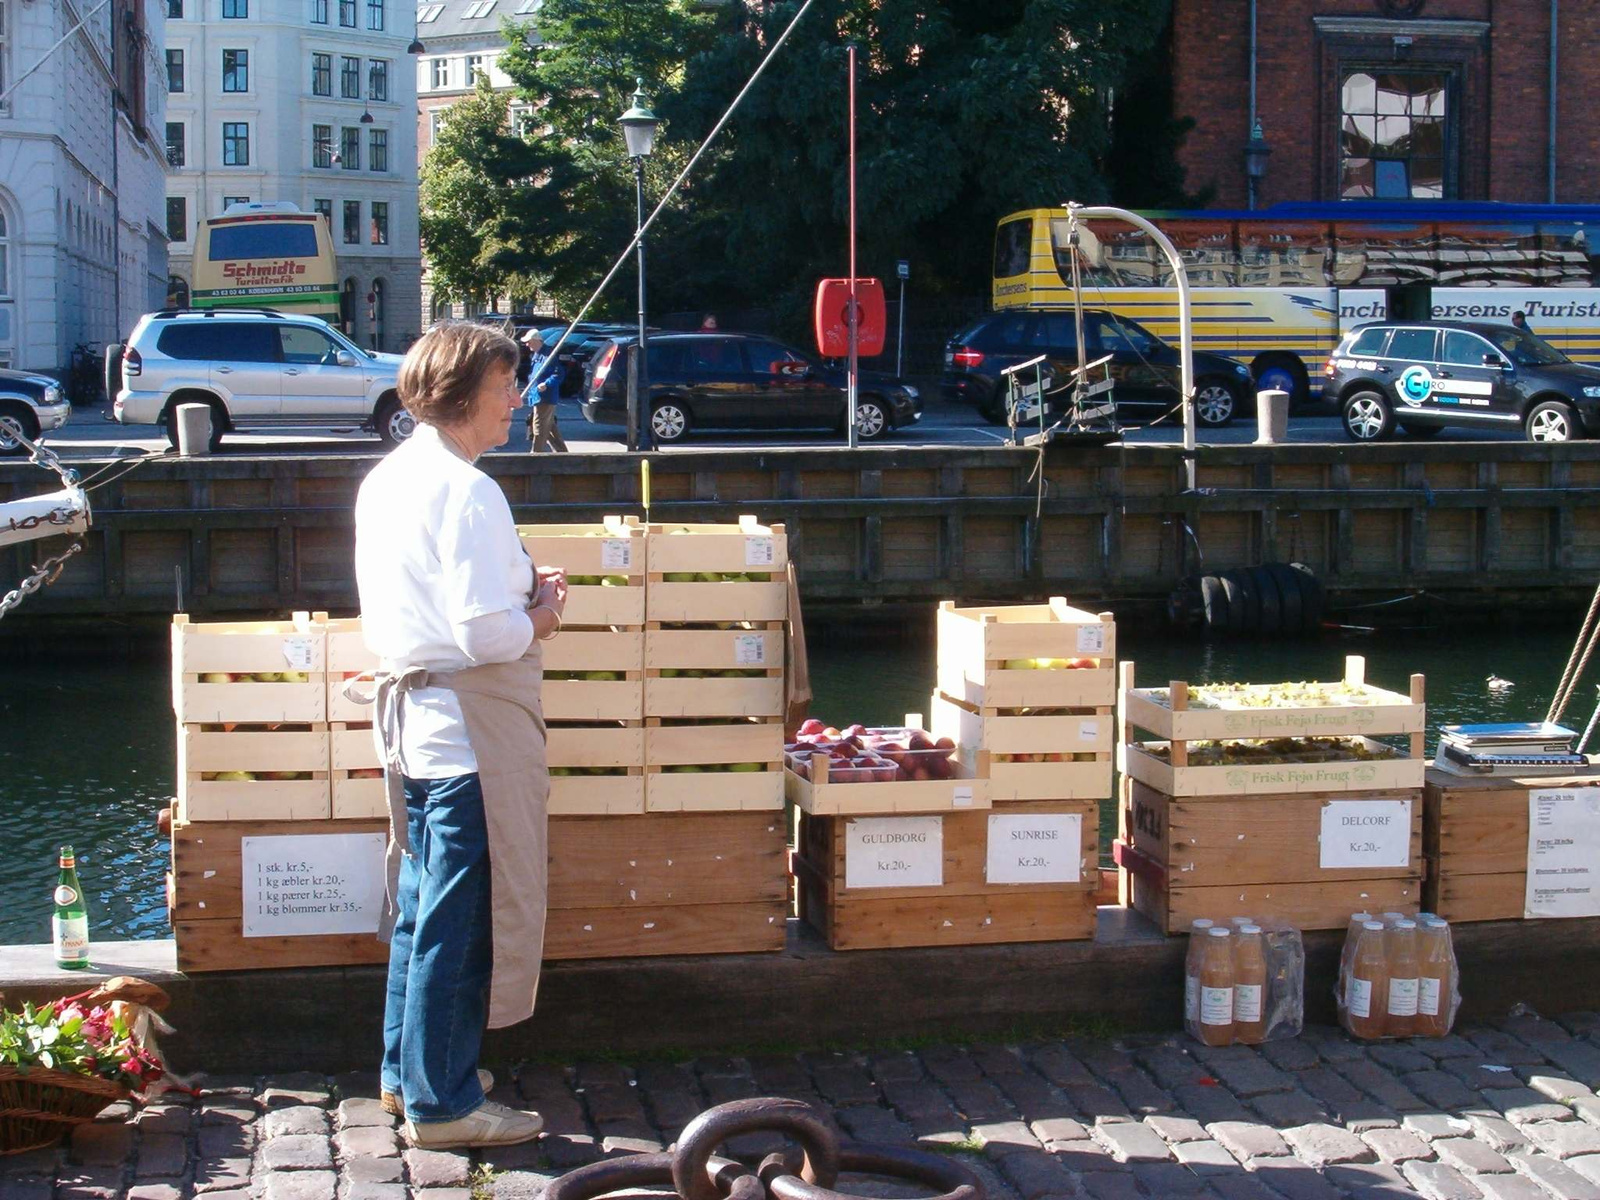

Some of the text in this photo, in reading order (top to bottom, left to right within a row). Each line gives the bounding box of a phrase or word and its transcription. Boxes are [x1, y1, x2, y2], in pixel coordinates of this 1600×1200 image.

[223, 260, 306, 277] Schmidts
[235, 275, 295, 285] Turisttrafik
[1524, 301, 1600, 317] Turist
[1251, 715, 1283, 727] Frisk
[1314, 714, 1347, 727] Frugt
[1252, 772, 1284, 784] Frisk
[1316, 770, 1350, 783] Frugt
[1342, 816, 1392, 826] DELCORF
[862, 832, 927, 844] GULDBORG
[1011, 830, 1058, 841] SUNRISE
[1350, 842, 1381, 852] Kr.20,-
[266, 862, 284, 873] stk.
[287, 862, 314, 873] kr.5,-
[878, 860, 912, 871] Kr.20,-
[1018, 857, 1051, 868] Kr.20,-
[266, 877, 279, 889] kg
[282, 876, 310, 886] æbler
[312, 875, 345, 886] kr.20,-
[266, 891, 279, 903] kg
[282, 892, 310, 902] pærer
[313, 889, 346, 900] kr.25,-
[267, 904, 280, 916] kg
[282, 903, 326, 914] blommer
[330, 902, 363, 913] kr.35,-
